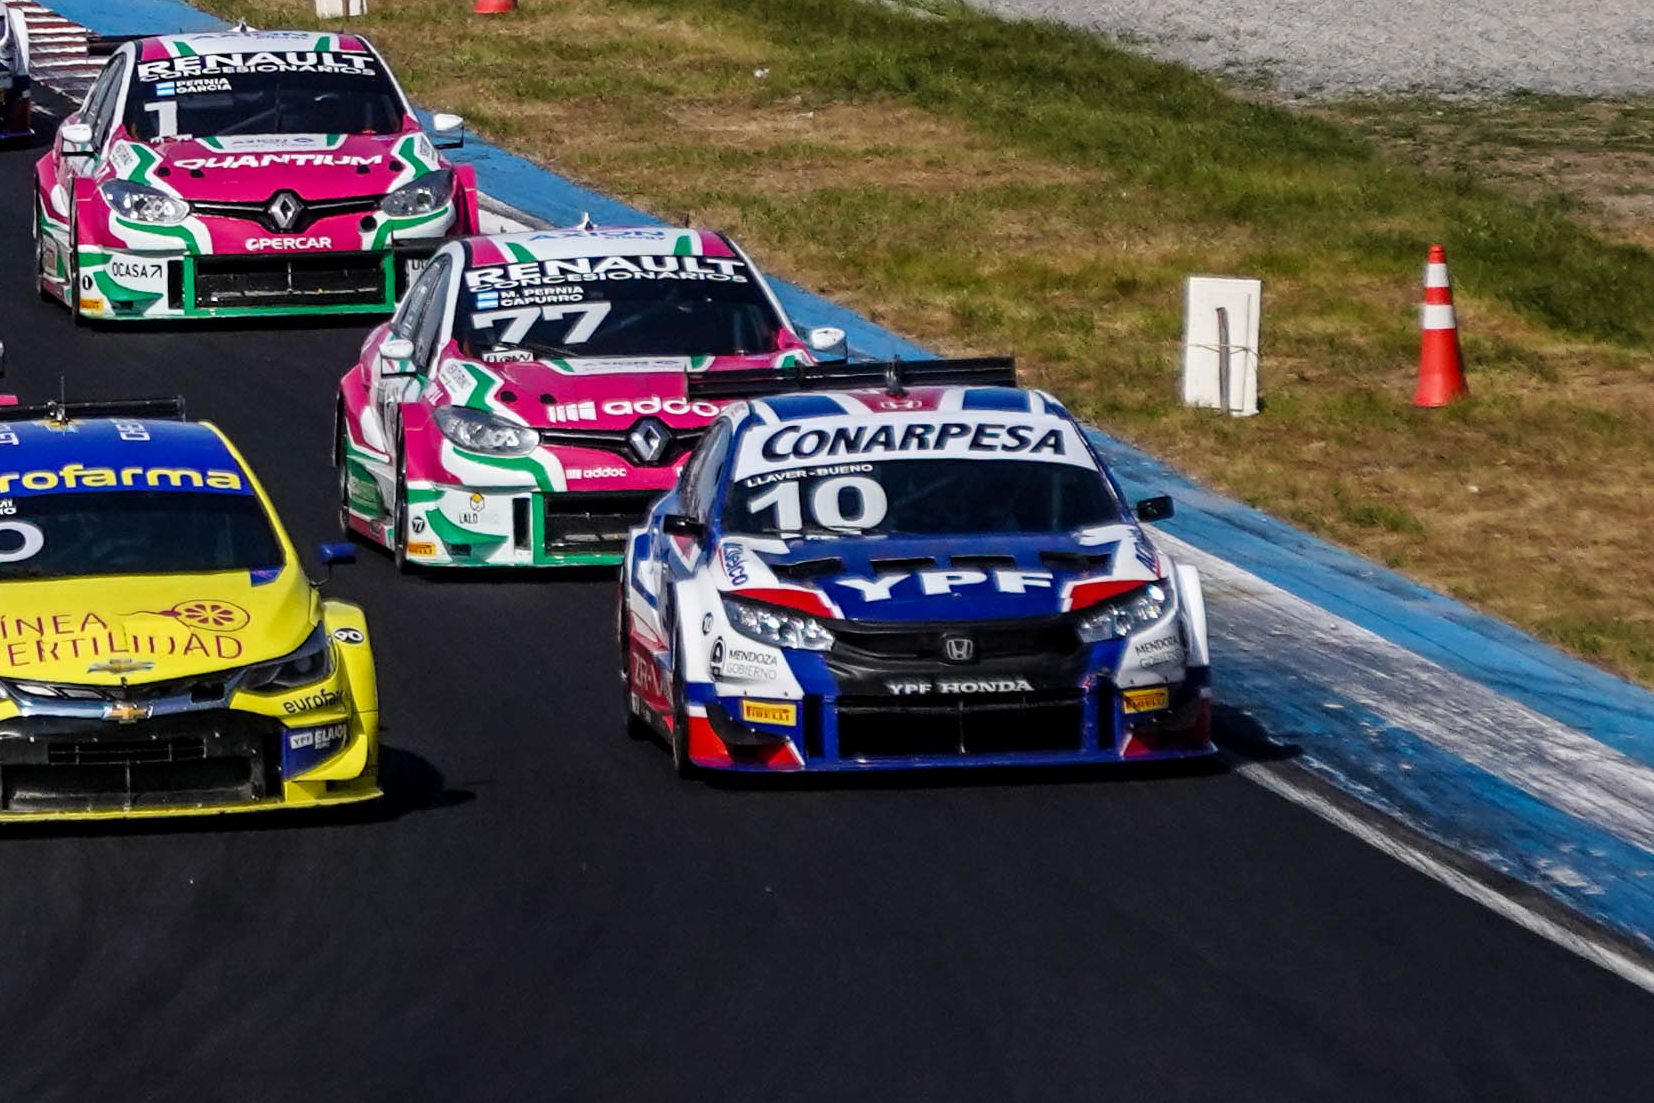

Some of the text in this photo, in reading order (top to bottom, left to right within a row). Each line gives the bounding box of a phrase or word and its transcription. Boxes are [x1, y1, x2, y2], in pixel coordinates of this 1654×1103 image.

[137, 52, 375, 78] RENAULT
[139, 64, 376, 82] CONCESIONARIOS
[175, 77, 230, 87] PERNIA
[175, 84, 232, 94] GARCIA
[143, 100, 180, 139] 1
[174, 154, 383, 169] QUANTIUM
[111, 261, 148, 278] OCASA
[465, 255, 747, 287] RENAULT
[468, 270, 749, 293] CONCESIONARIOS
[501, 285, 584, 300] M. PERNIA
[501, 294, 584, 307] CAPURRO
[471, 301, 612, 345] 77
[602, 395, 726, 417] addo
[761, 421, 1066, 463] CONARPESA
[583, 467, 627, 479] addoc
[751, 475, 888, 539] 10
[839, 570, 1052, 603] YPF
[334, 629, 364, 644] 90
[729, 648, 778, 667] MENDOZA
[726, 661, 778, 680] GOBIERNO
[887, 679, 1034, 695] YPF HONDA
[746, 705, 790, 722] PIRELLI
